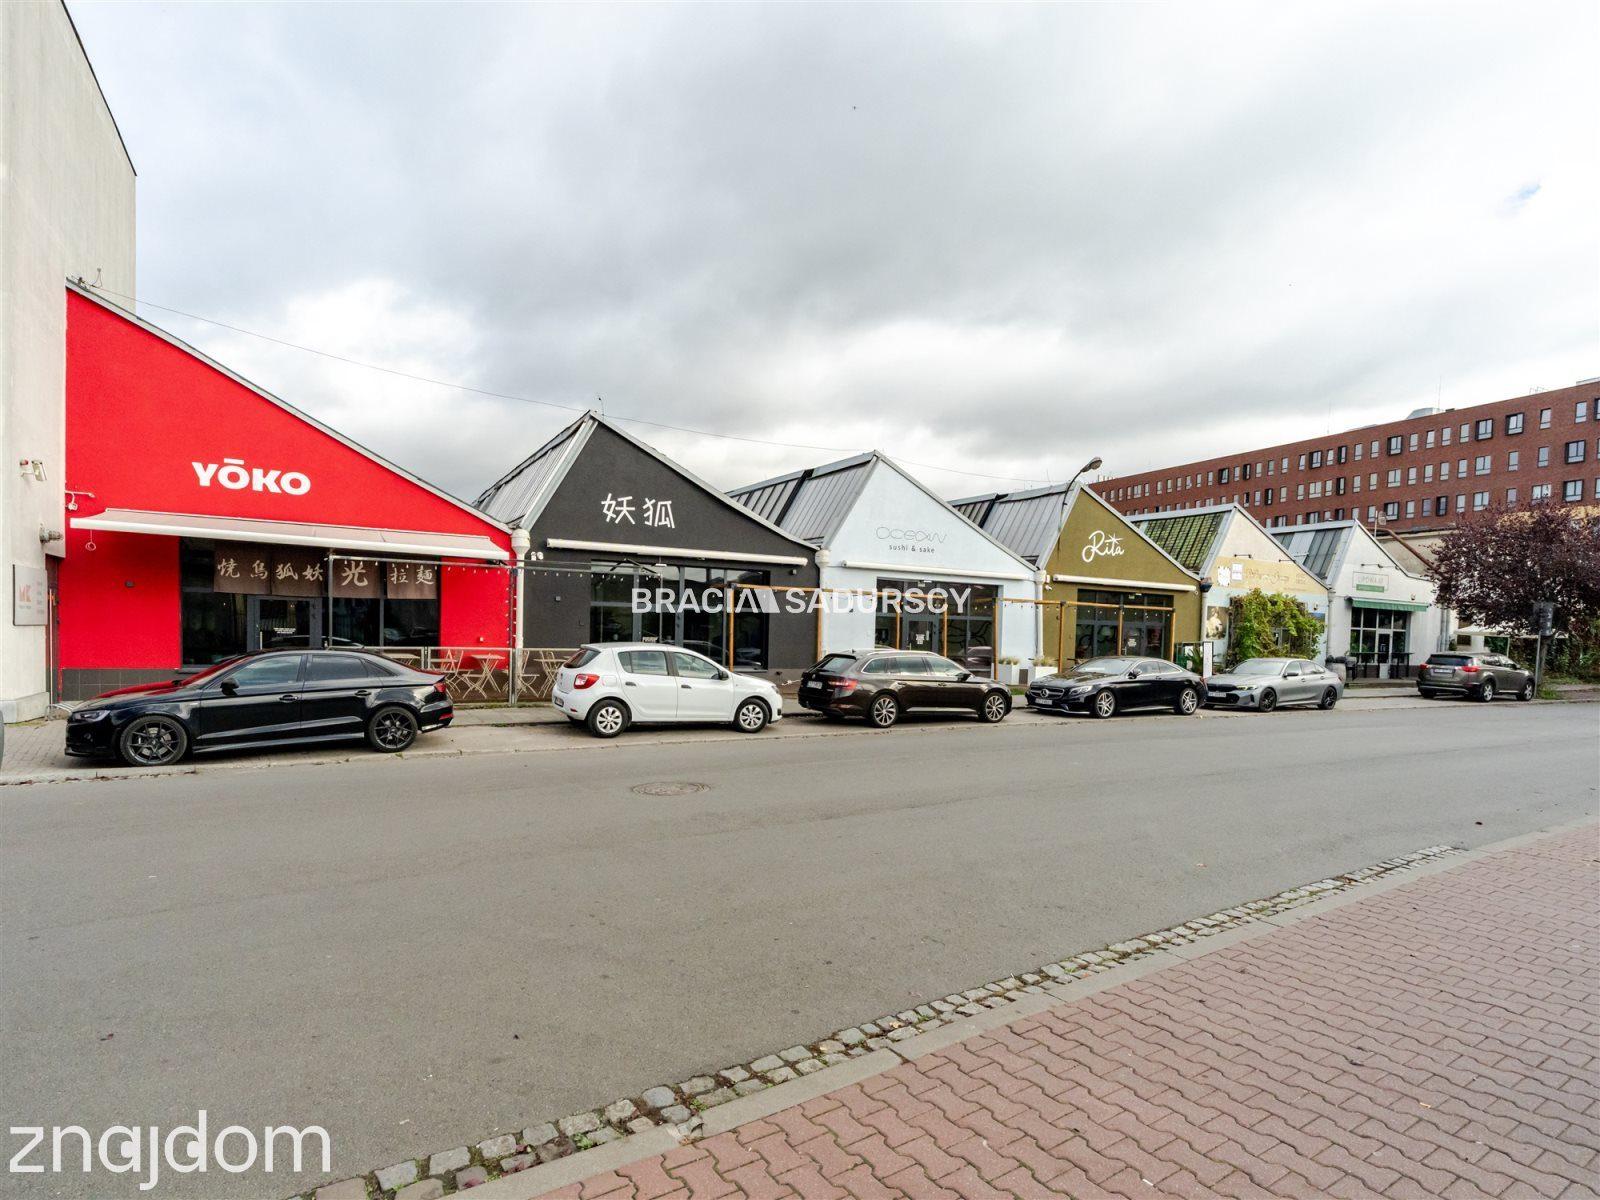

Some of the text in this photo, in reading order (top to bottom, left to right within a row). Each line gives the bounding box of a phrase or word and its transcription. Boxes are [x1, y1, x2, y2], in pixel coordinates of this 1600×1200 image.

[601, 492, 676, 528] 妖狐
[1082, 530, 1125, 563] Rita
[341, 560, 369, 587] 光
